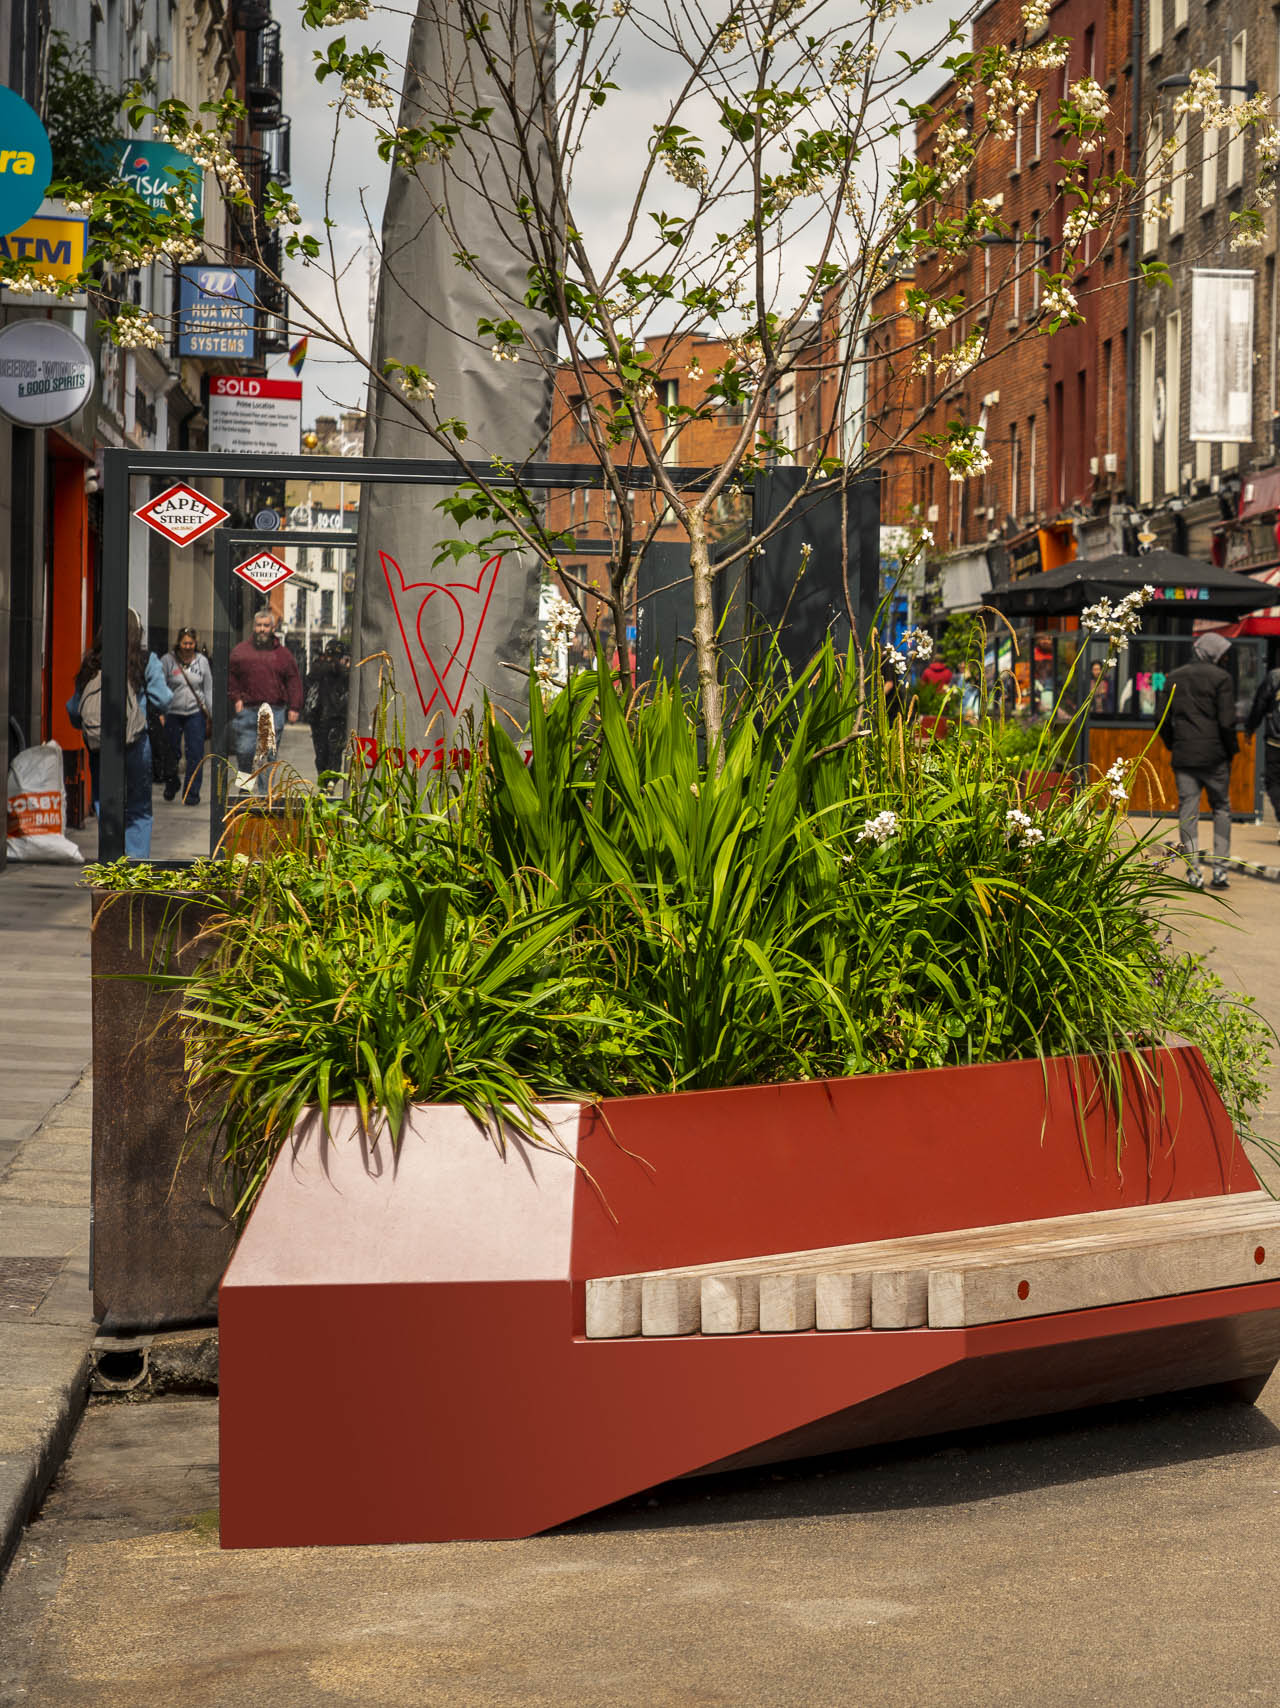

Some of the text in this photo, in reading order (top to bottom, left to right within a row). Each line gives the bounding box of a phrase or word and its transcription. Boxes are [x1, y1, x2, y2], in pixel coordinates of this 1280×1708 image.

[192, 304, 244, 319] HUA WEI
[185, 320, 248, 337] COMPUTER
[190, 336, 245, 352] SYSTEMS
[27, 379, 51, 393] GOOD
[52, 374, 85, 391] SPIRITS
[216, 378, 261, 396] SOLD
[152, 498, 209, 517] CAPEL
[160, 515, 204, 524] STREET
[245, 560, 284, 573] CAPEL
[1153, 587, 1209, 600] KREWE
